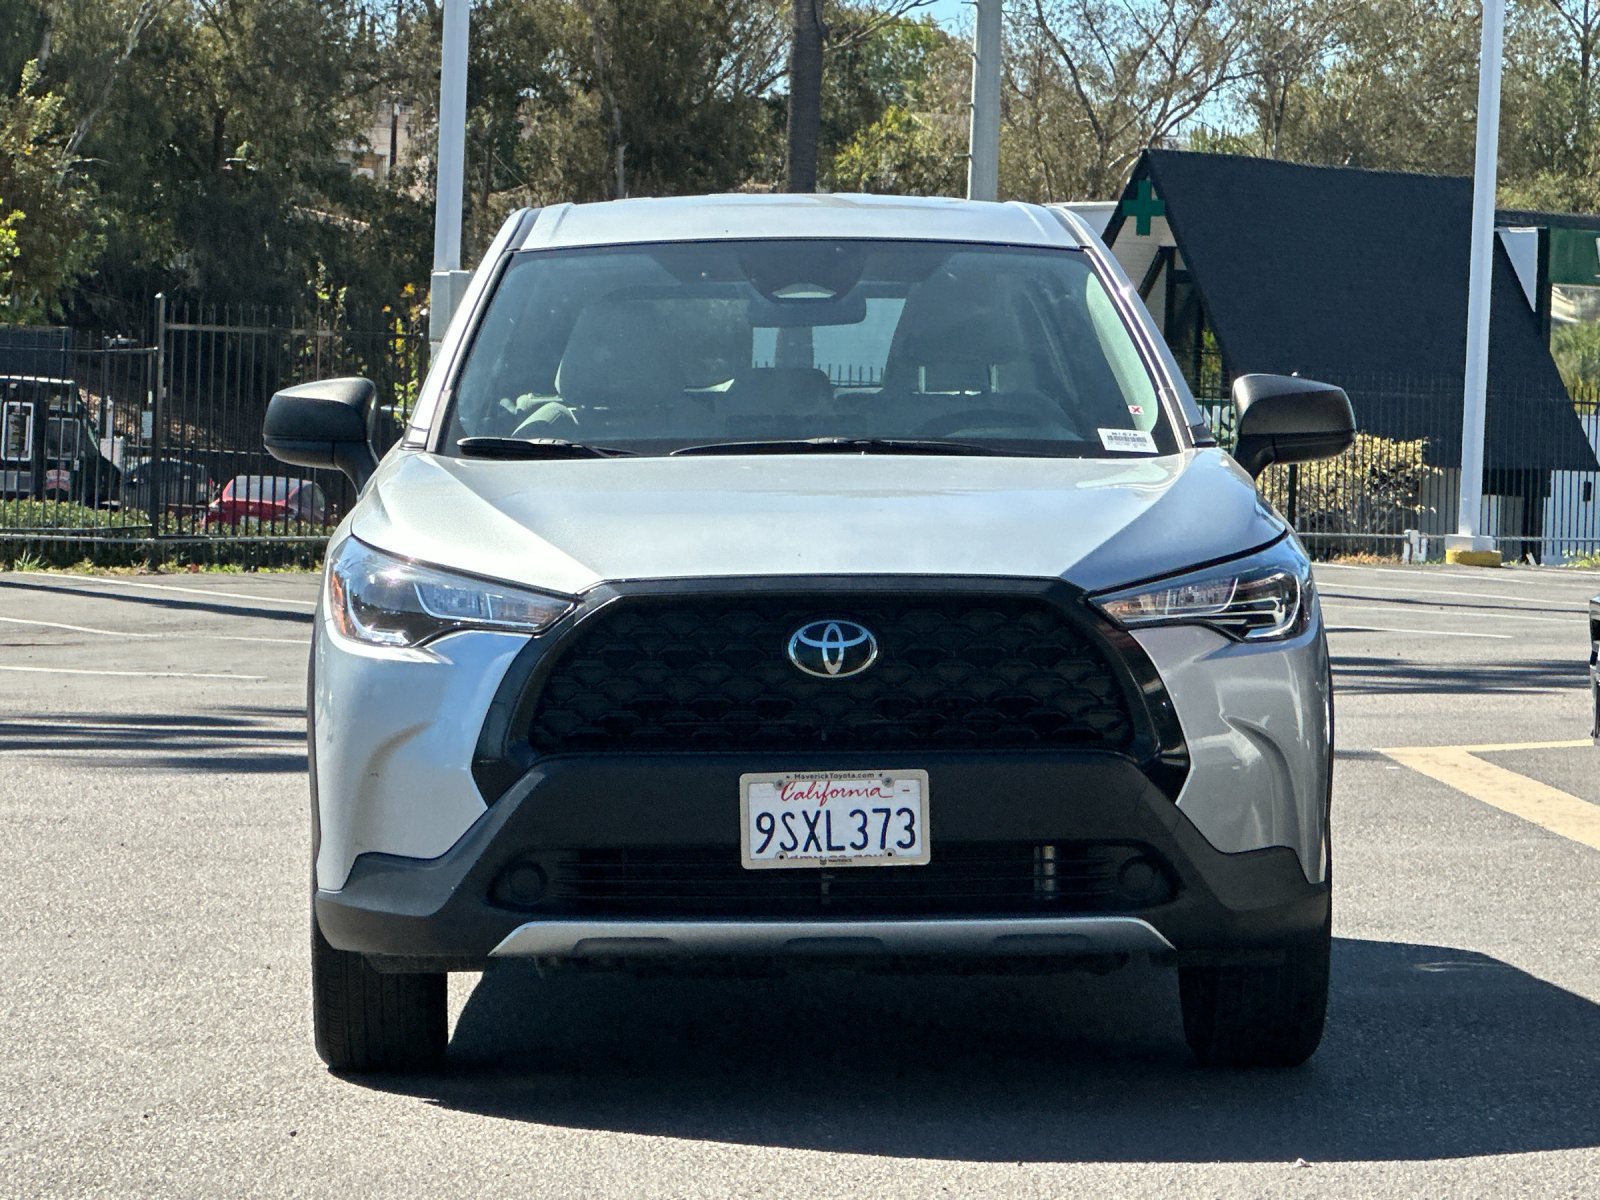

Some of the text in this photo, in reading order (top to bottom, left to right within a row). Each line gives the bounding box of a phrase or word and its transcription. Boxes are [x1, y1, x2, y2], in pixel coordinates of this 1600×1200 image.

[794, 772, 875, 780] MaverickToyota.com
[780, 779, 894, 807] California
[756, 807, 916, 854] 9SXL373
